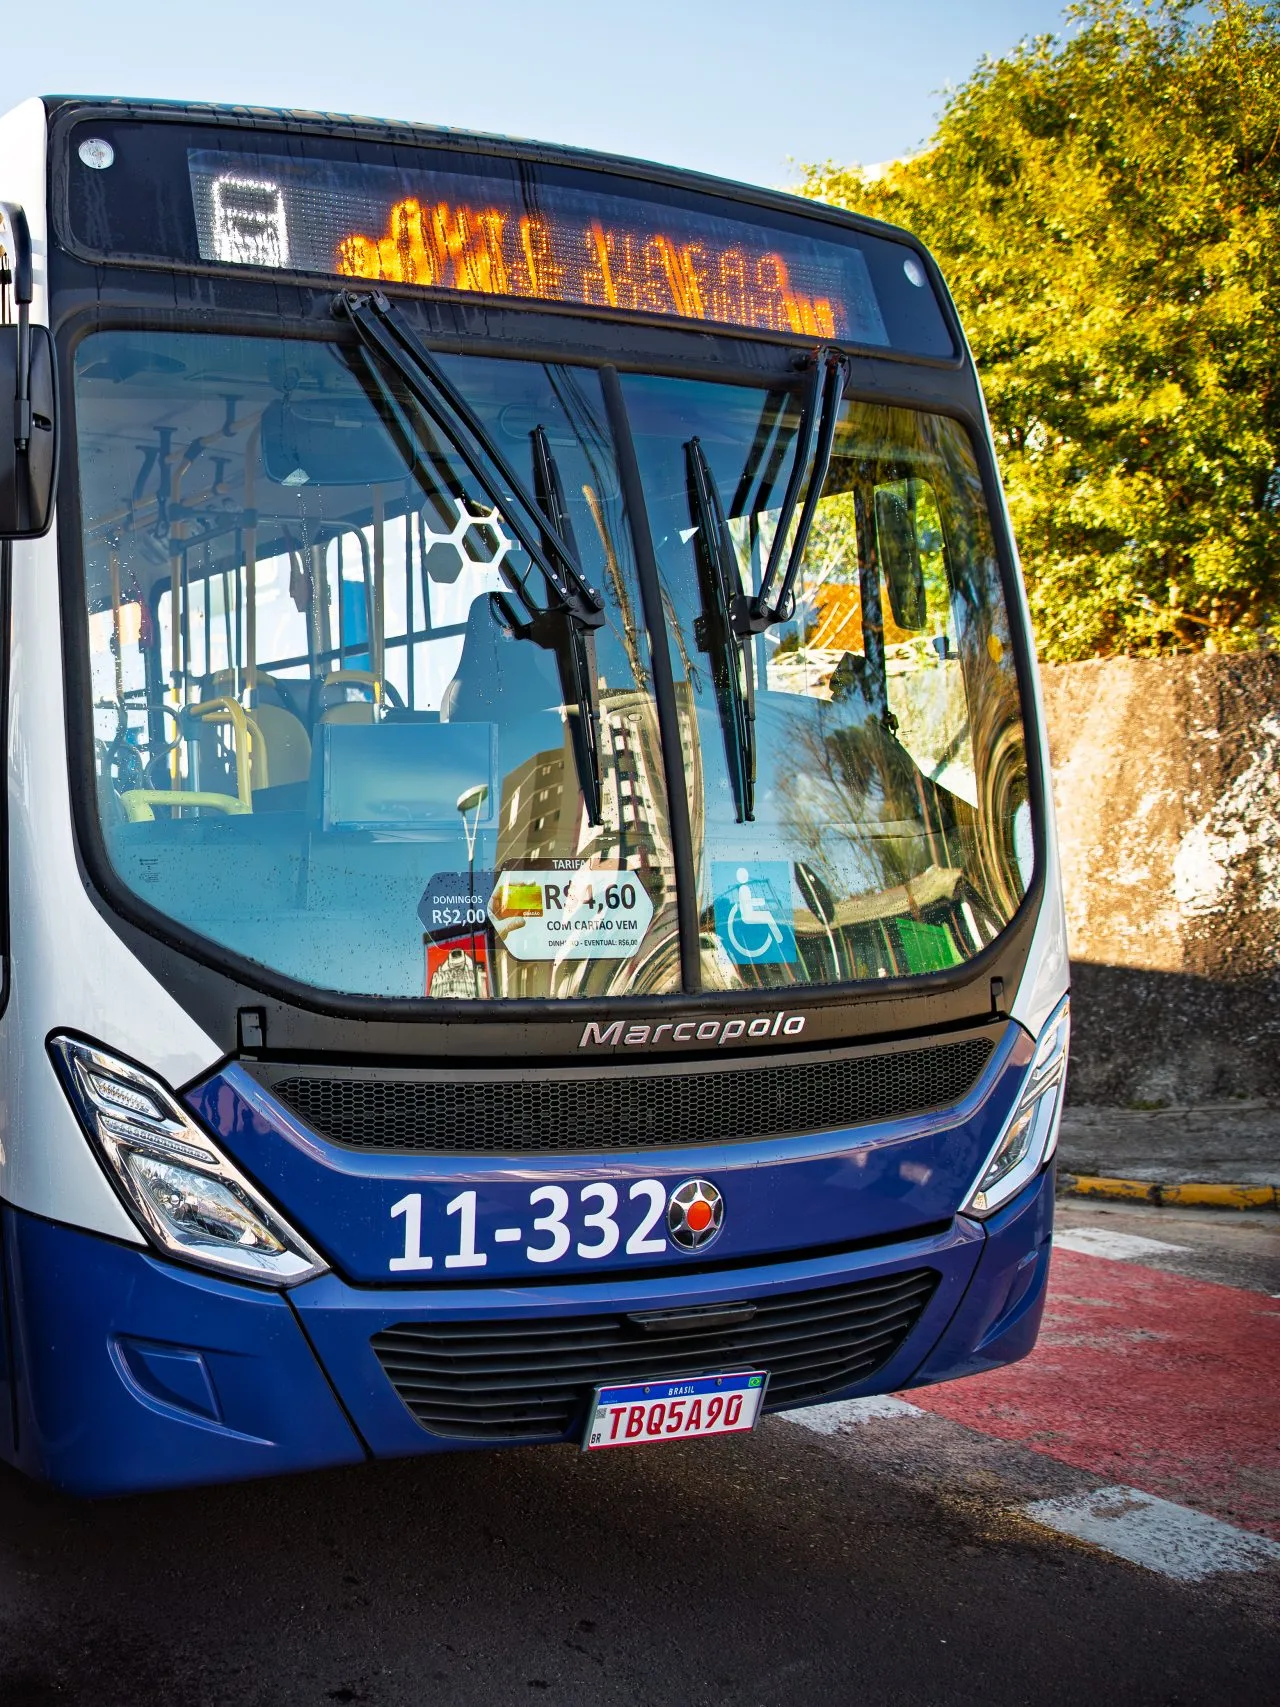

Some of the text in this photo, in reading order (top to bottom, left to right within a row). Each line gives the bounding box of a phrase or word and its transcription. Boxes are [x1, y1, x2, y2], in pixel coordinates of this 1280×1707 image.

[552, 859, 587, 869] TARIFA
[432, 895, 483, 904] DOMINGOS
[432, 907, 486, 926] R$2,00
[547, 918, 638, 931] COM CARTÃO VEM
[579, 1011, 806, 1049] Marcopolo
[389, 1179, 668, 1272] 11-332
[668, 1386, 695, 1396] BRASIL
[609, 1394, 743, 1440] TBQ5A90
[591, 1433, 602, 1443] BR
